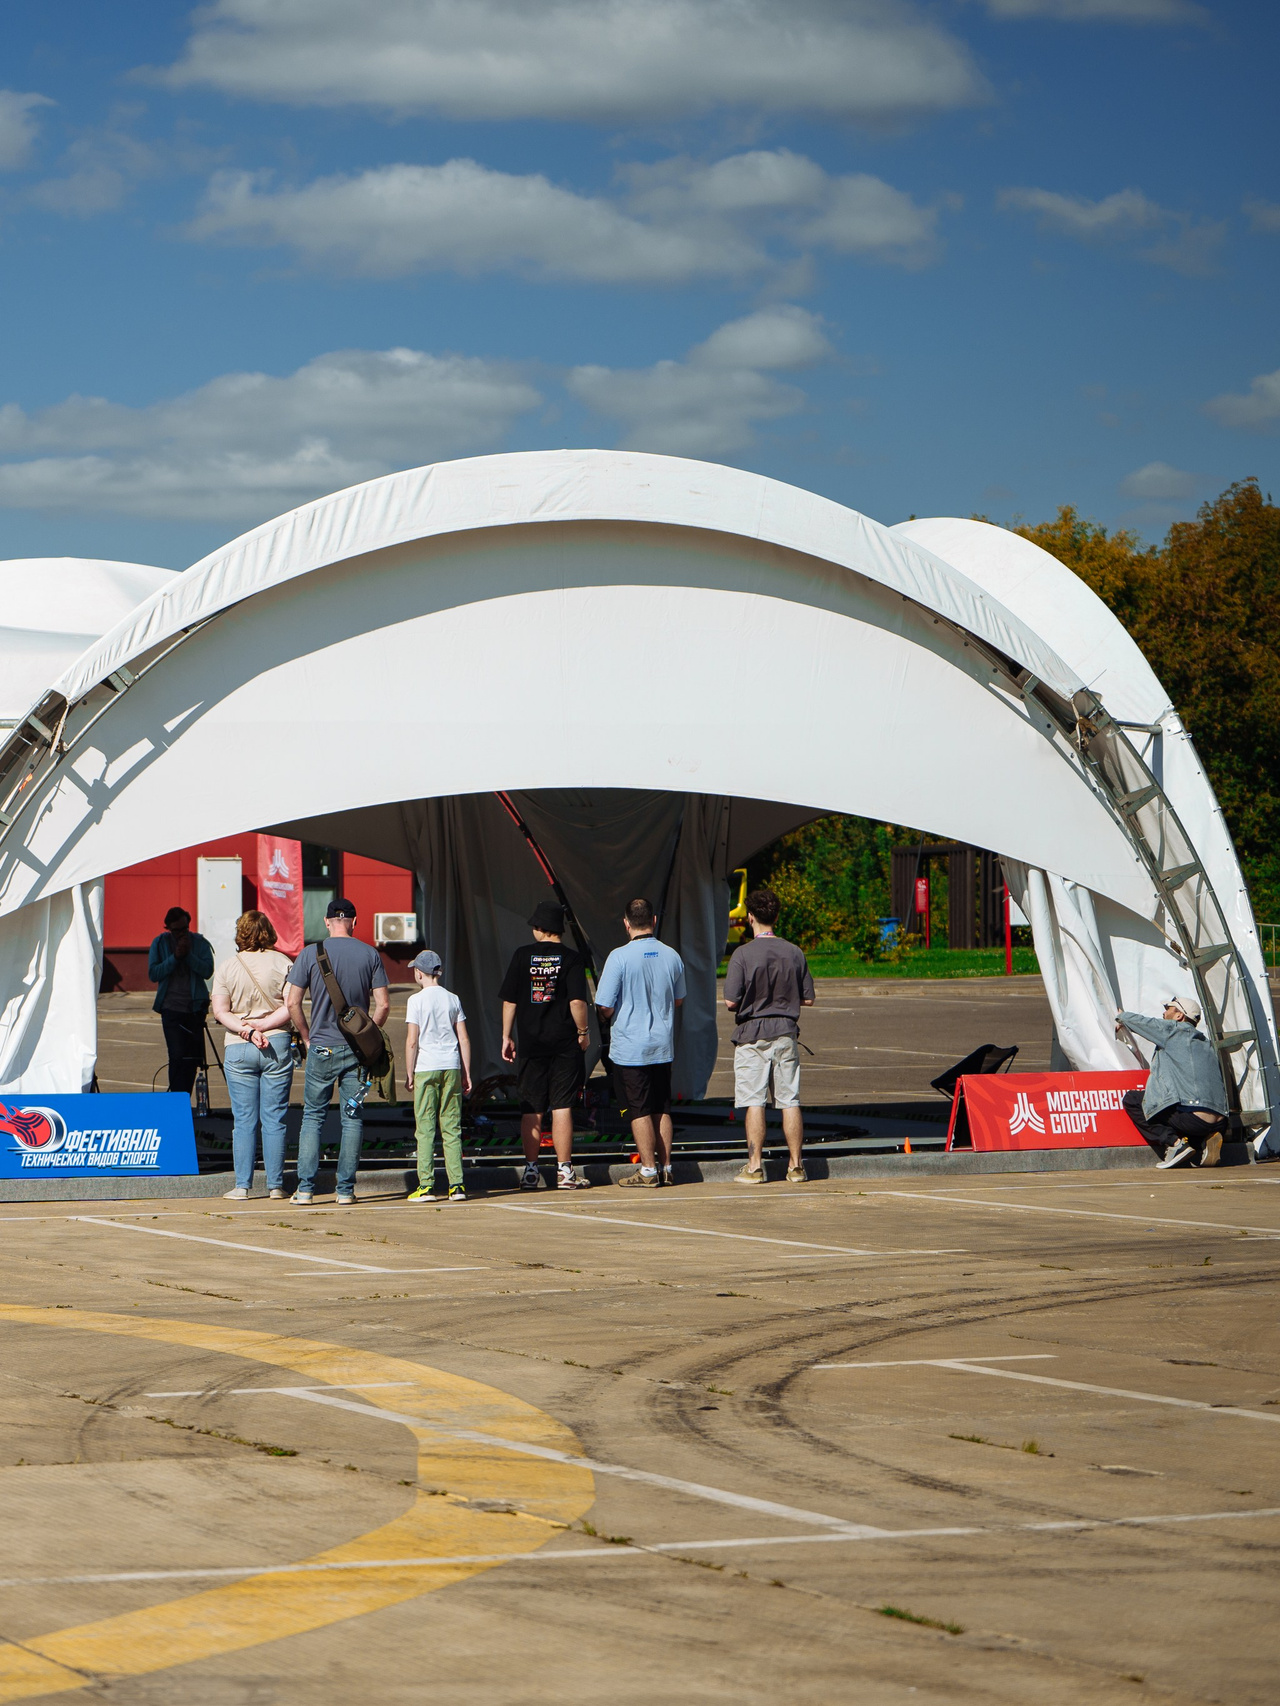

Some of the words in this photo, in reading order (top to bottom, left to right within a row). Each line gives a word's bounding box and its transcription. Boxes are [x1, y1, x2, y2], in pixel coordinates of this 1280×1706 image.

[1046, 1084, 1145, 1112] МОСКОВСК
[1049, 1112, 1097, 1134] СПОРТ
[64, 1128, 162, 1152] ФЕСТИВАЛЬ
[21, 1152, 87, 1167] ТЕХНИЧЕСКИХ
[87, 1152, 120, 1168] ВИДОВ
[120, 1151, 158, 1165] СПОРТА
